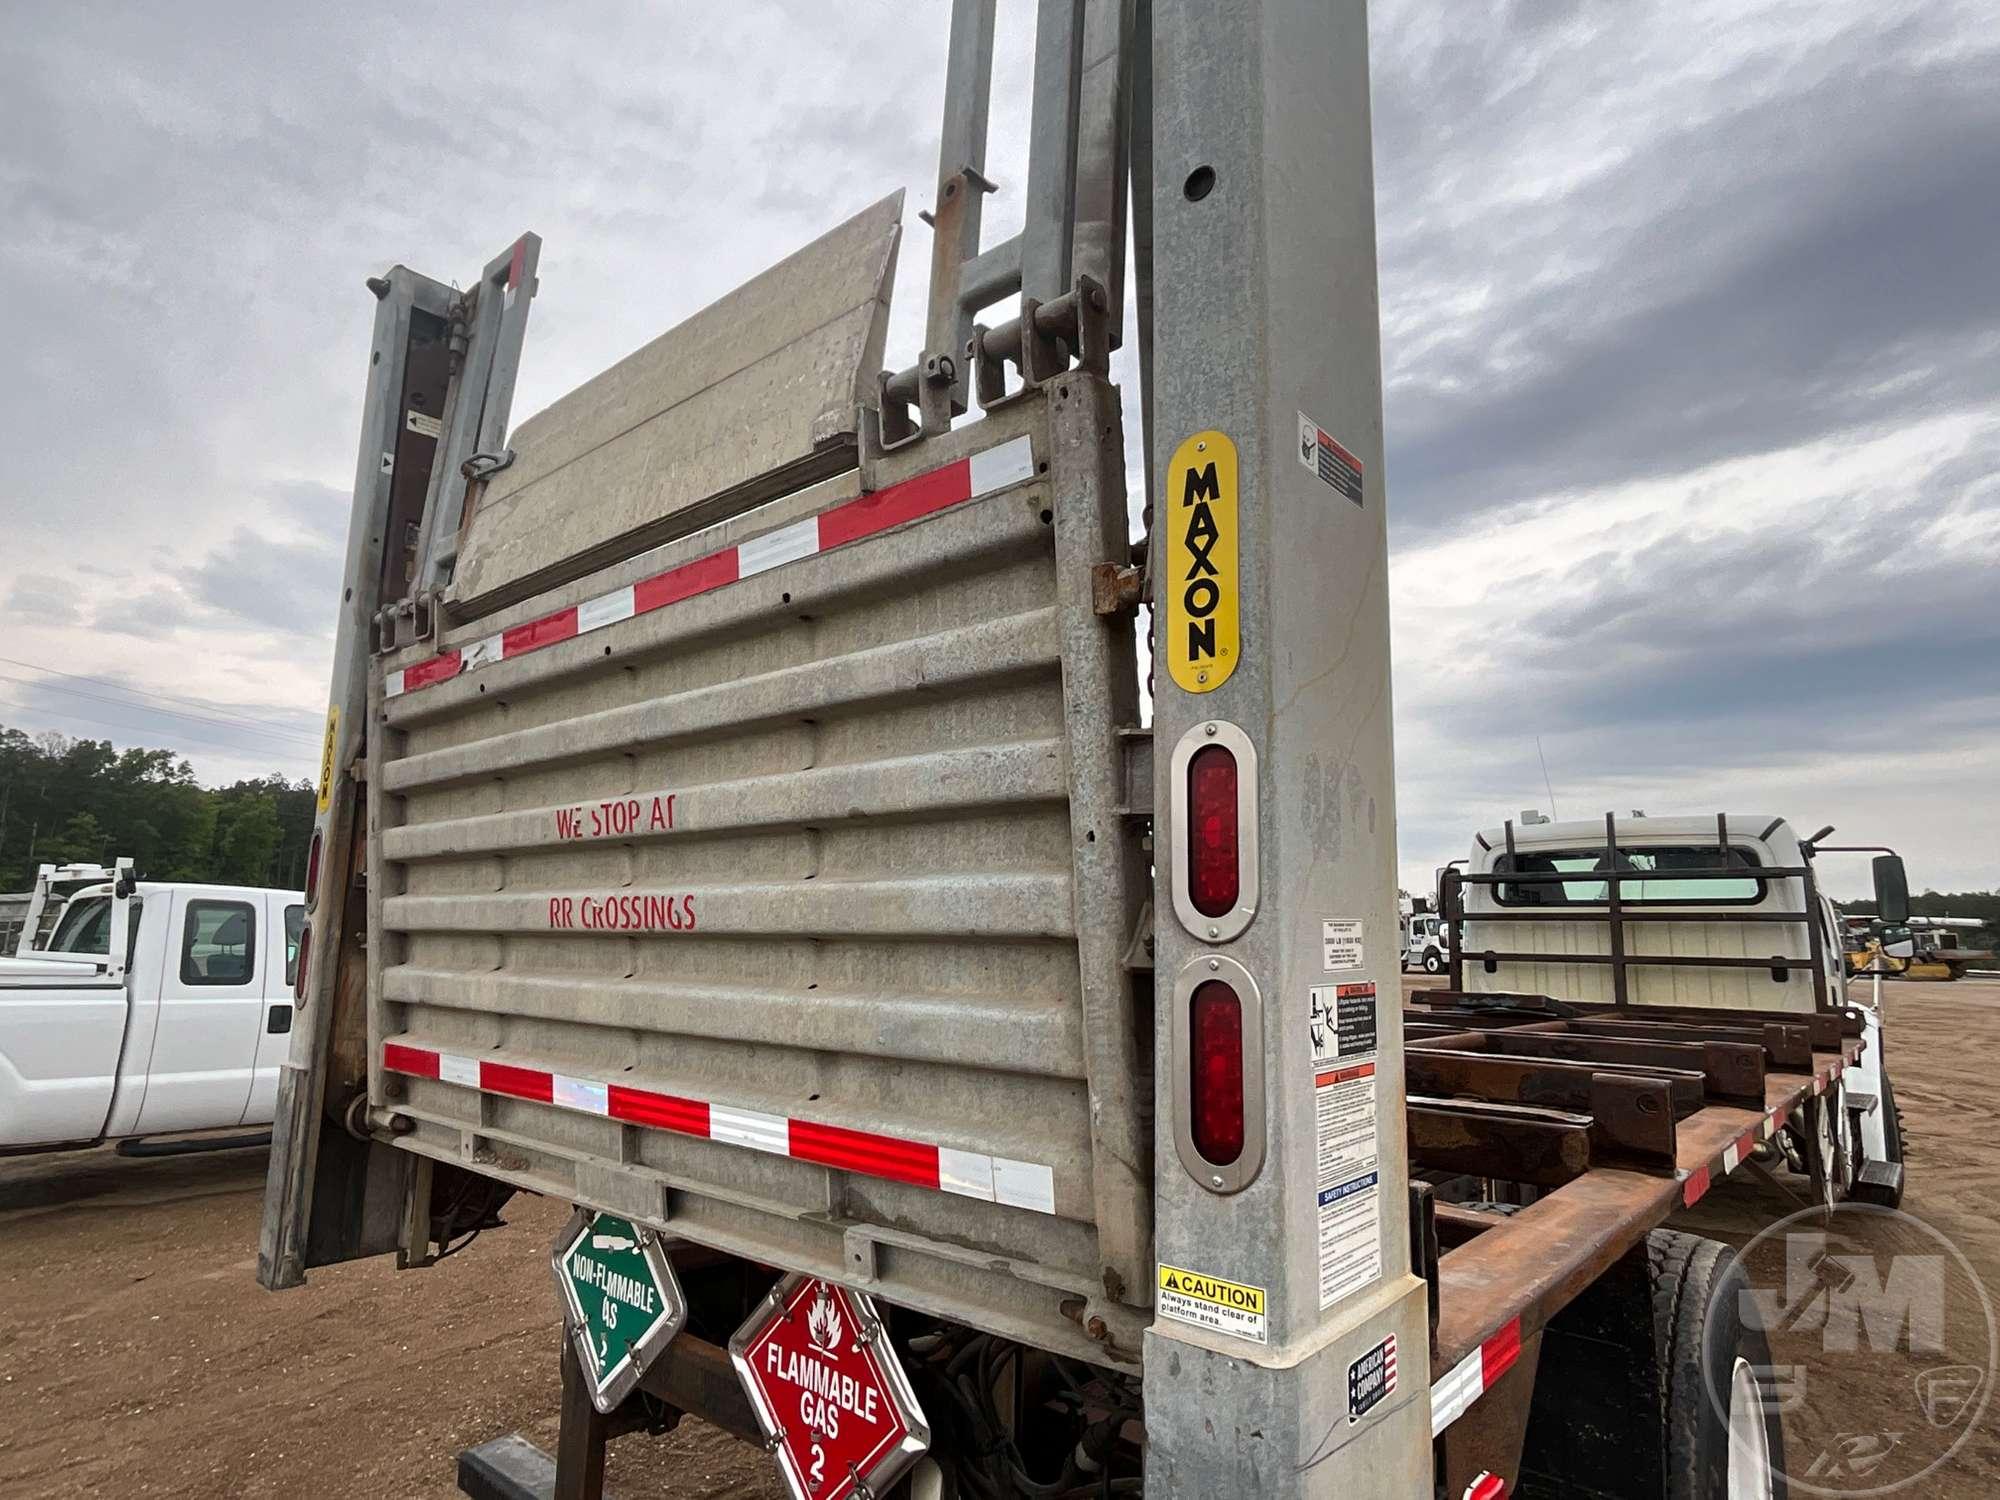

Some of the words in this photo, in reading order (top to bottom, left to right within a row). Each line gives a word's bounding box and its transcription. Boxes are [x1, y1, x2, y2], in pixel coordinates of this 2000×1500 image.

[1183, 461, 1220, 662] MAXON
[556, 807, 583, 839] WE
[591, 799, 640, 836] STOP
[549, 897, 574, 929] RR
[581, 894, 696, 930] CROSSINGS
[1161, 1291, 1192, 1307] Always
[1194, 1301, 1220, 1314] stand
[1222, 1309, 1245, 1321] clear
[1247, 1315, 1257, 1324] of
[1161, 1302, 1198, 1319] platform
[1182, 1276, 1257, 1309] CAUTION
[767, 1342, 879, 1425] FLAMMABLE
[800, 1391, 840, 1440] GAS
[809, 1444, 825, 1482] 2
